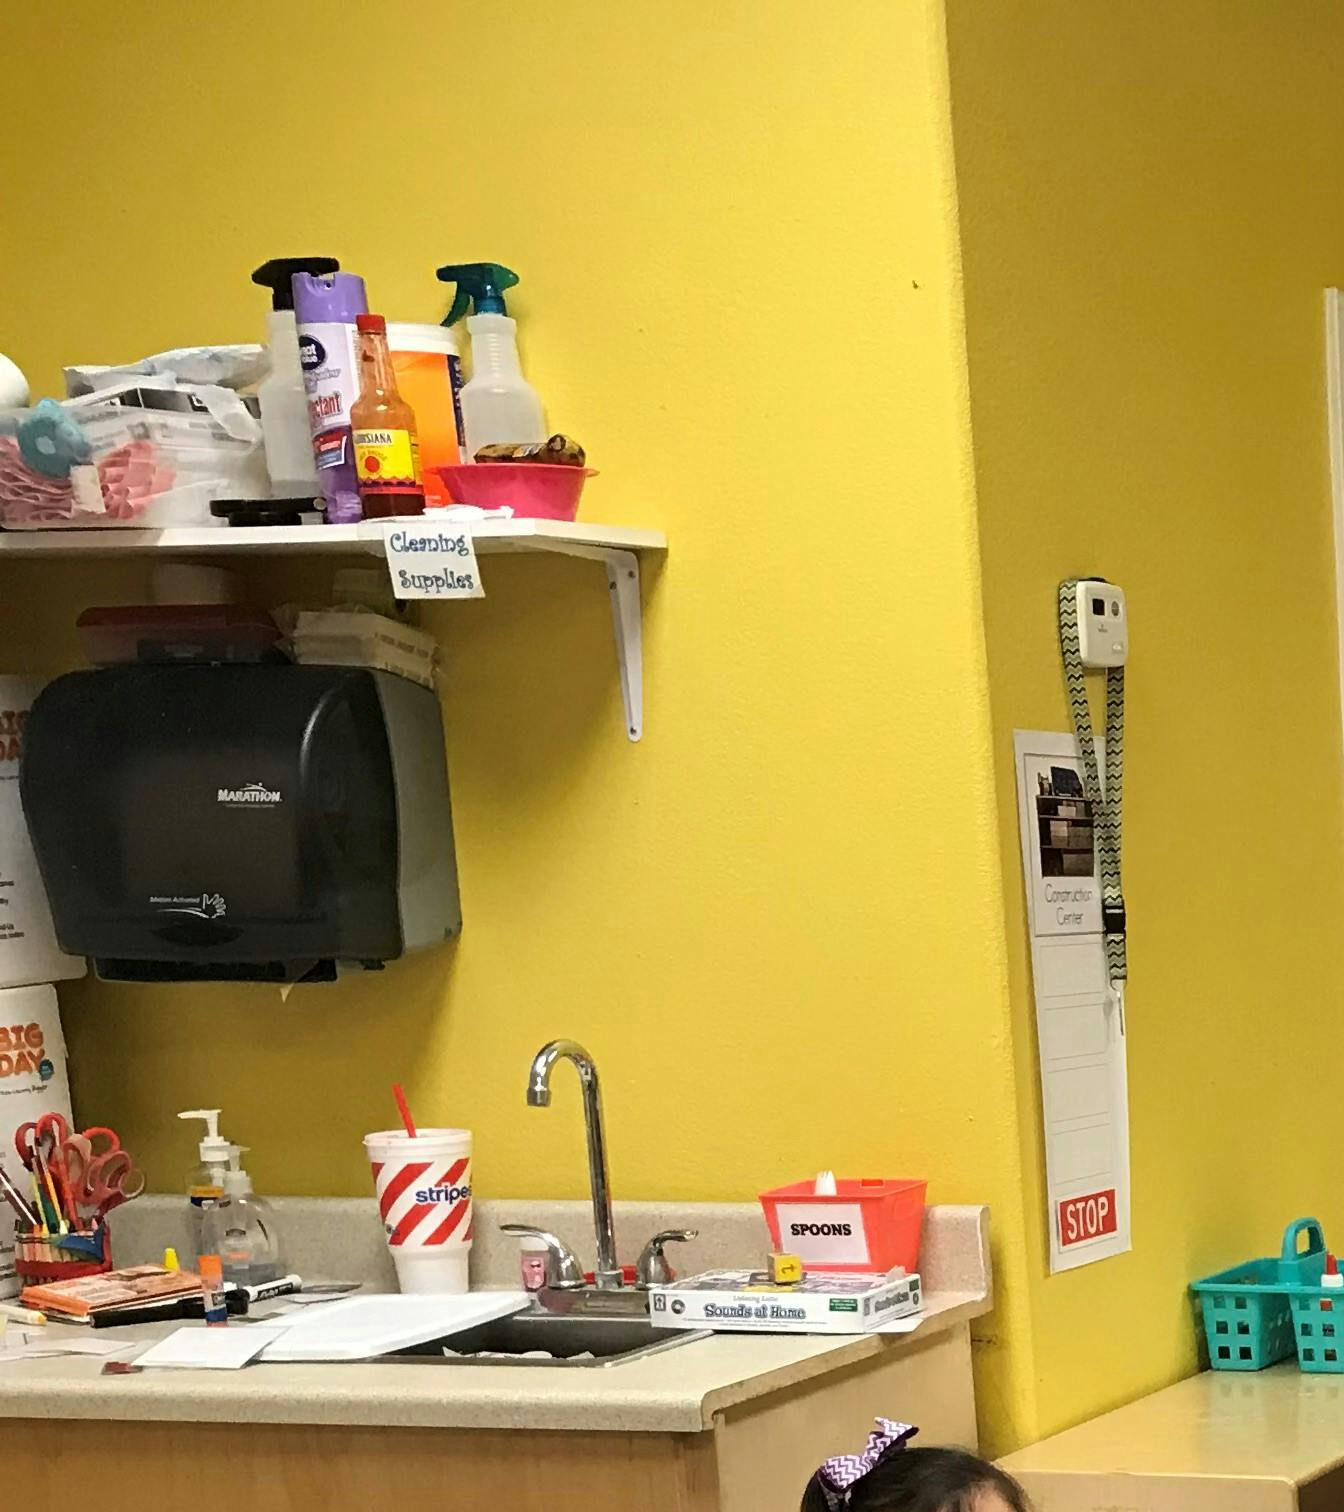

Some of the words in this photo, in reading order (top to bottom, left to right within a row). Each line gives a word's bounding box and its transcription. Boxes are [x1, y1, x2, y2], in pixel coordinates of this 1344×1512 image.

[390, 531, 471, 557] Cleaning
[398, 568, 475, 593] Supplies
[217, 788, 281, 802] MARATHON
[1066, 1196, 1108, 1240] STOP
[790, 1223, 852, 1236] SPOONS
[704, 1302, 751, 1318] Sounds
[752, 1303, 768, 1317] at
[770, 1305, 807, 1320] Home
